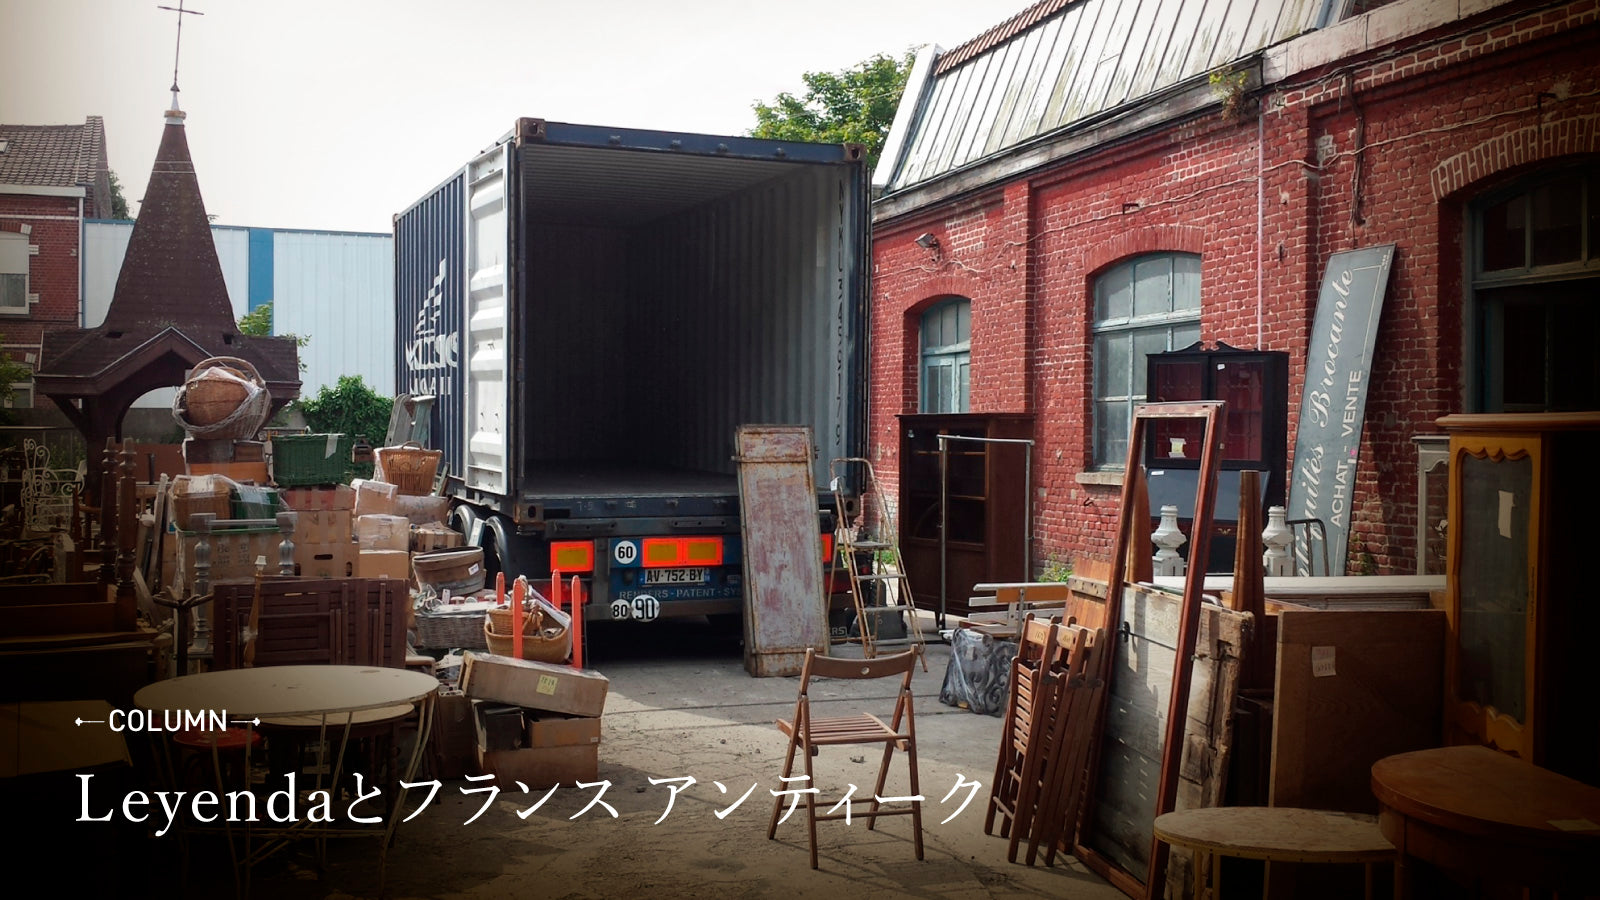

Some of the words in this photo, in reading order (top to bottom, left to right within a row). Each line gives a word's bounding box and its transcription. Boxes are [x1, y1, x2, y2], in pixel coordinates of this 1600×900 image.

[1308, 269, 1353, 428] Brocante
[1331, 460, 1349, 528] ACHAT
[1341, 370, 1363, 438] VENTE
[617, 546, 634, 558] 60
[676, 588, 715, 598] PATENT
[612, 604, 628, 618] 80
[635, 598, 656, 620] 90
